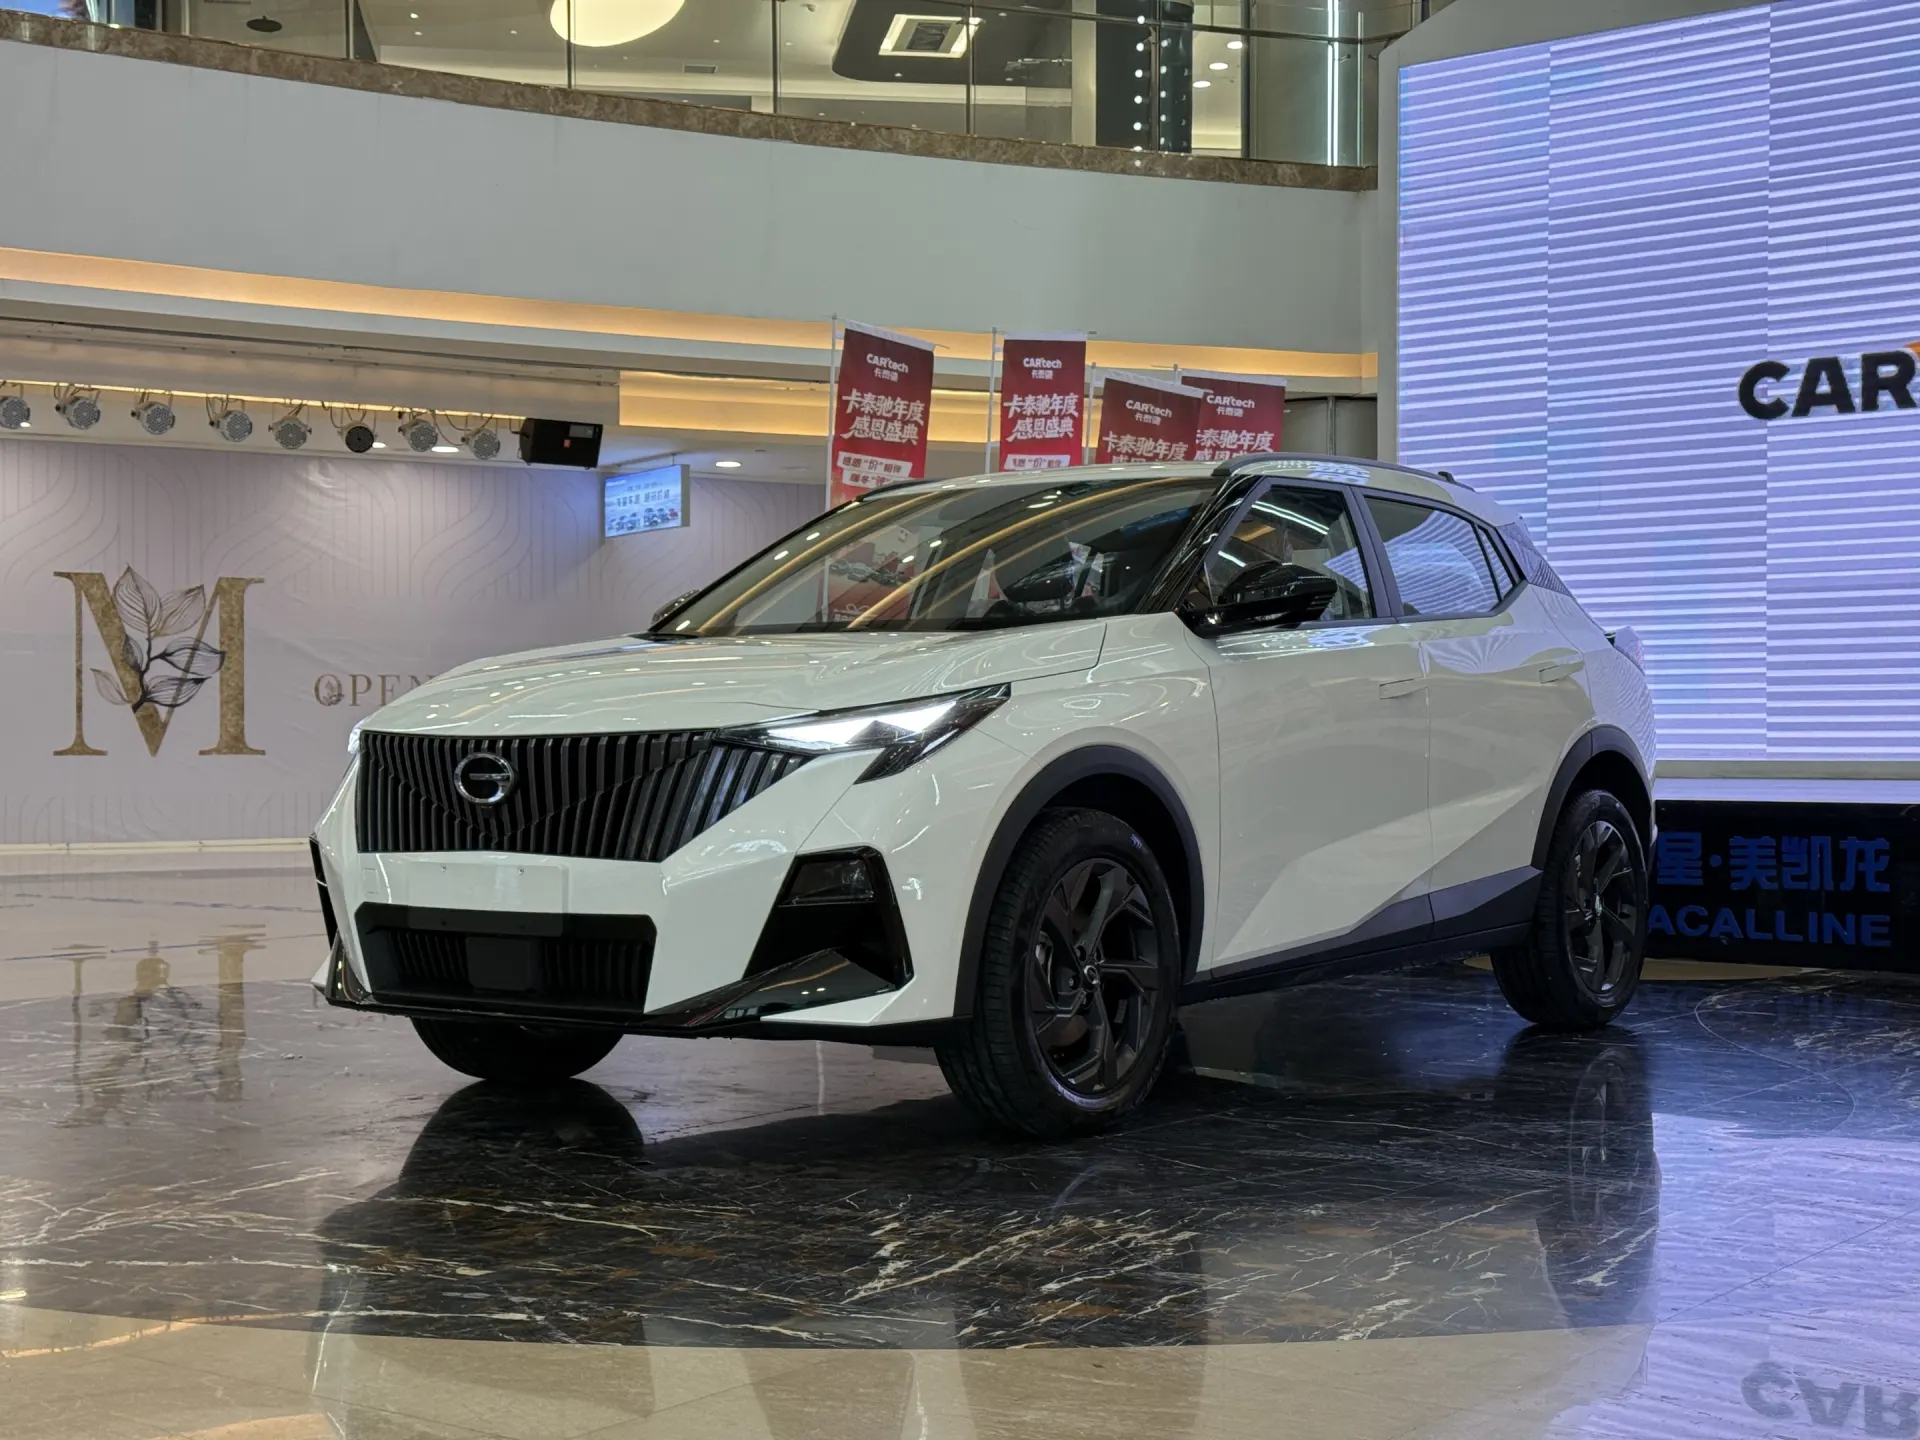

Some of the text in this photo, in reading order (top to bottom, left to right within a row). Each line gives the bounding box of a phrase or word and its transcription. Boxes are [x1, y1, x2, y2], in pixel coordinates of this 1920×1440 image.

[842, 388, 925, 426] 卡泰驰年度
[1003, 392, 1079, 419] 卡泰驰年度
[840, 415, 919, 446] 感恩盛典
[1005, 416, 1075, 442] 感恩盛典
